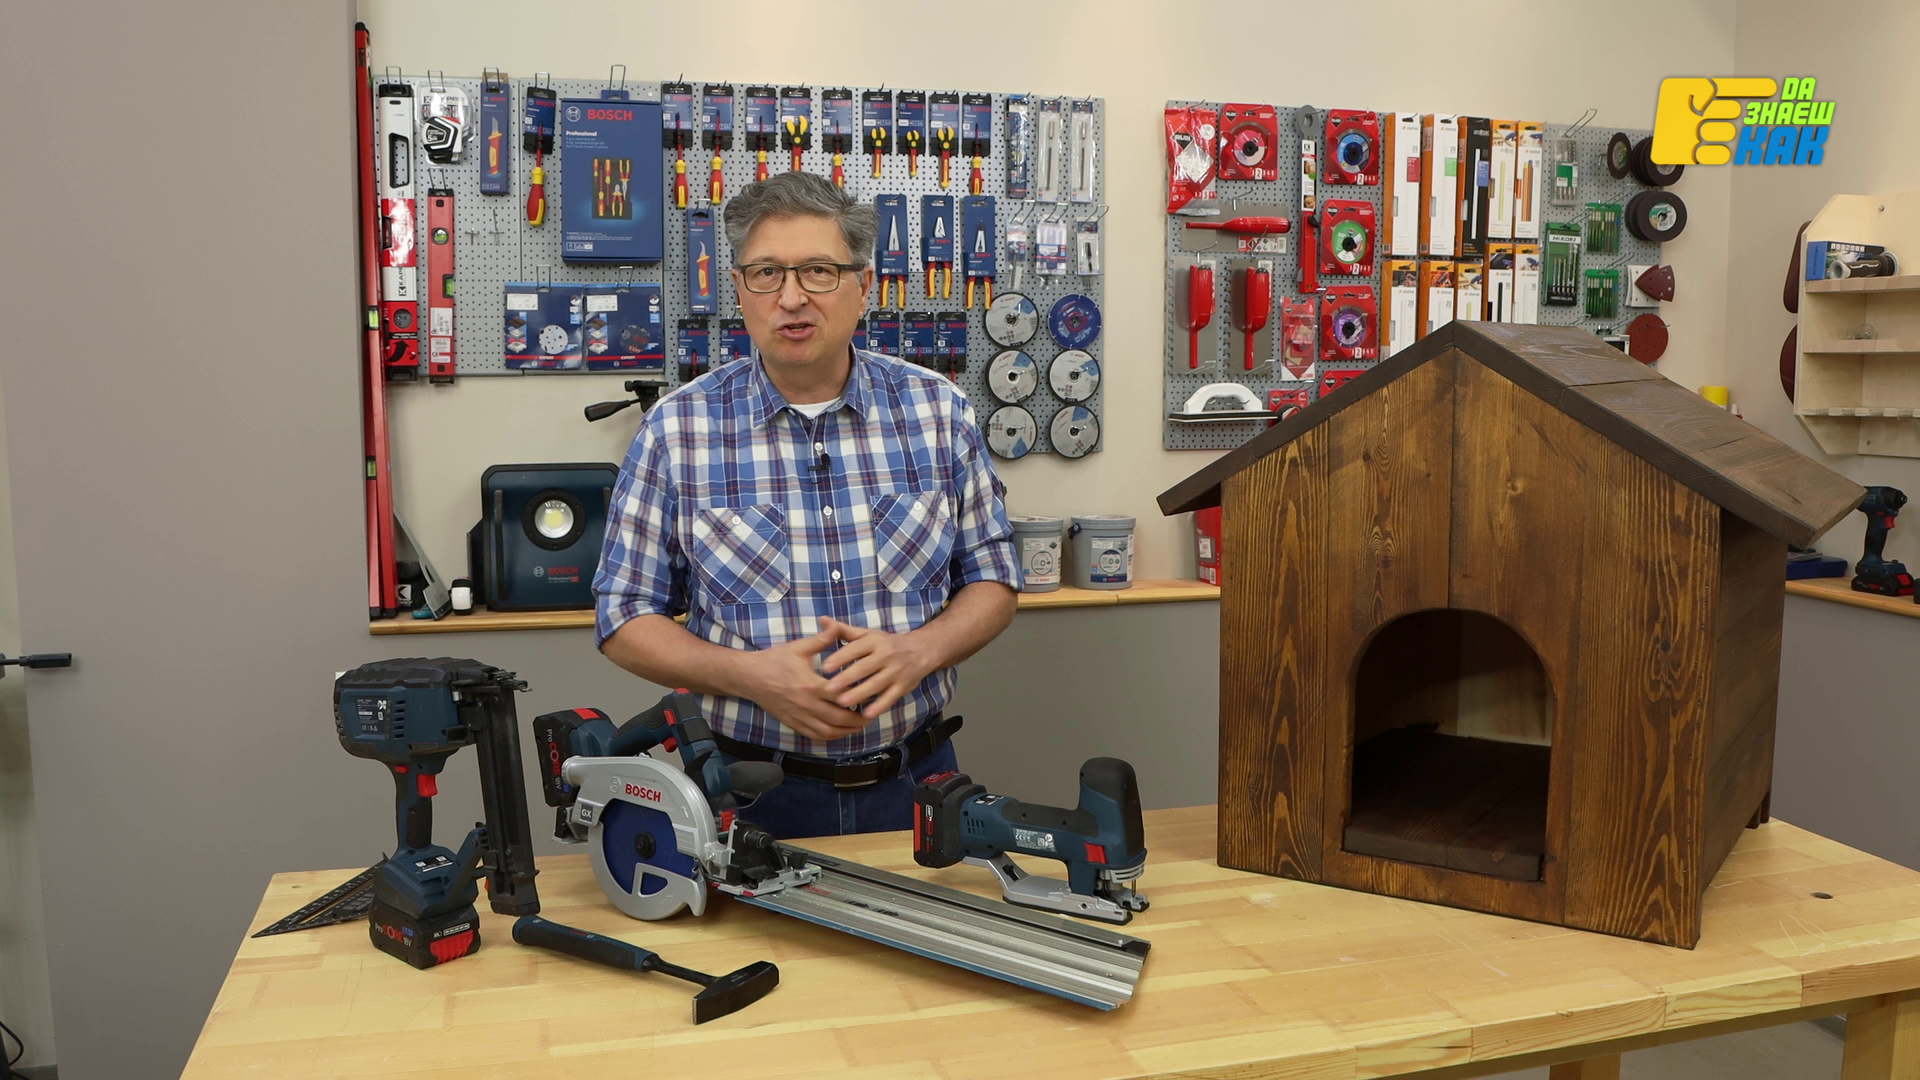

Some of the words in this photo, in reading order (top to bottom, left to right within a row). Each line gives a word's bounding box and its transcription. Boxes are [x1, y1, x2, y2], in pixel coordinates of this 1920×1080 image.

[587, 109, 633, 120] BOSCH
[625, 783, 662, 803] BOSCH
[581, 808, 592, 818] GX
